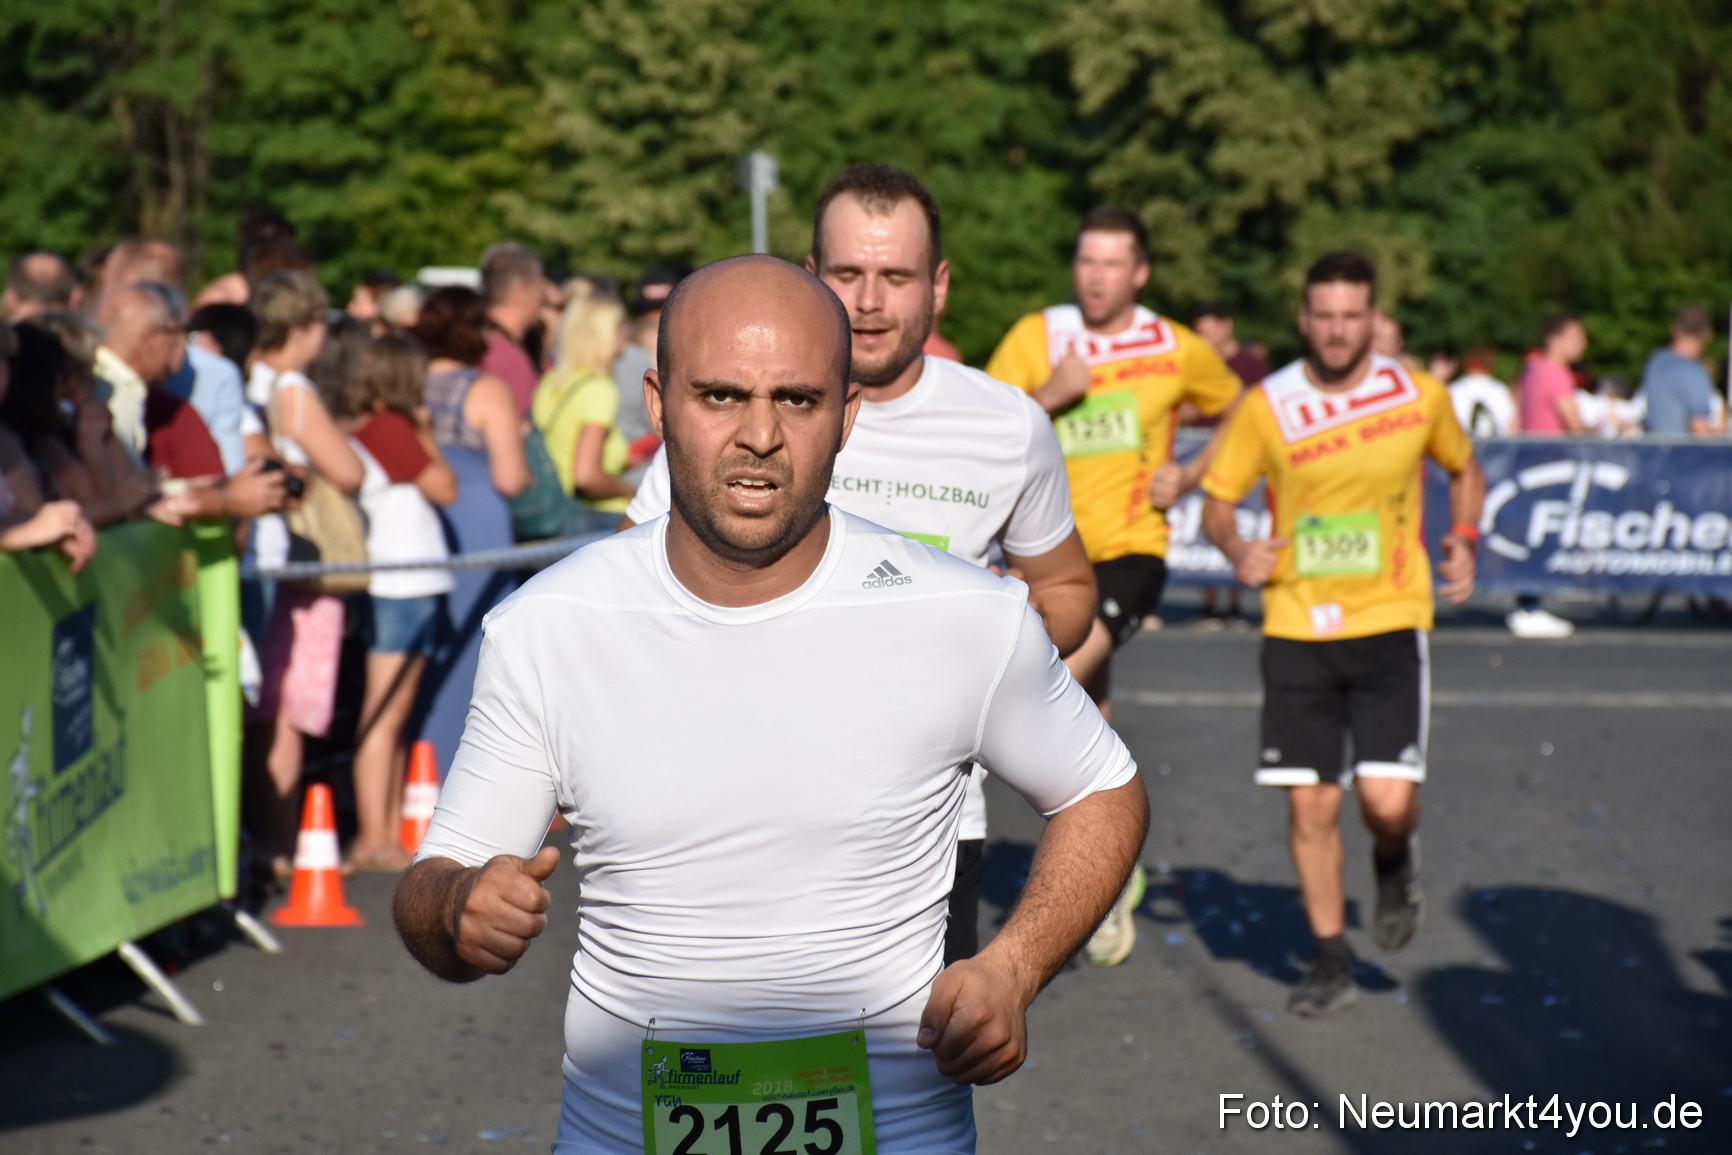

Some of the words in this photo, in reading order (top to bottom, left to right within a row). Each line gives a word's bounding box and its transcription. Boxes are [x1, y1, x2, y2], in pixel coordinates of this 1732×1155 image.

[1067, 411, 1125, 440] 1251
[1289, 434, 1350, 467] MAX
[831, 476, 882, 494] ECHT
[896, 482, 990, 509] HOLZBAU
[1527, 498, 1732, 550] Fische
[1305, 532, 1368, 560] 1309
[862, 574, 912, 590] adidas
[668, 1069, 742, 1085] firmenlauf
[752, 1080, 794, 1096] 2018
[668, 1097, 844, 1155] 2125
